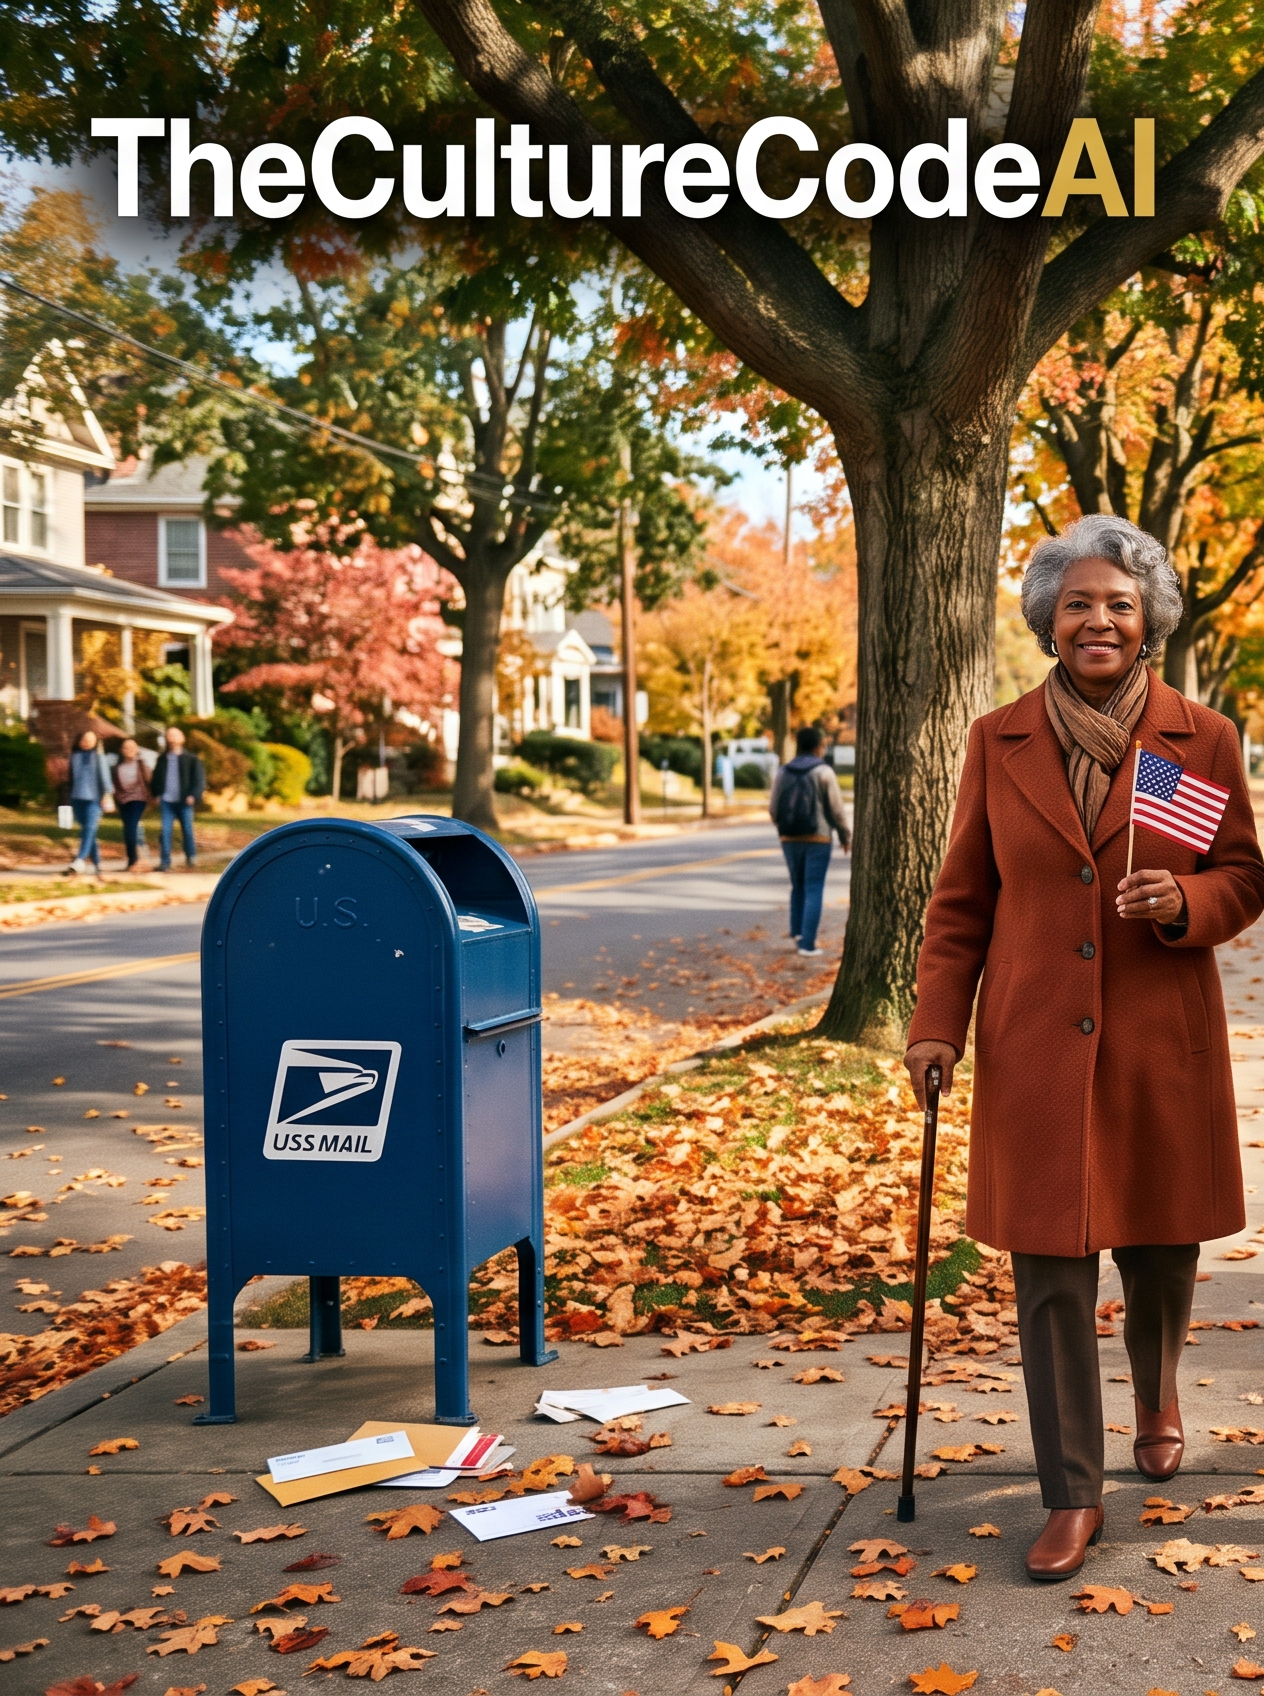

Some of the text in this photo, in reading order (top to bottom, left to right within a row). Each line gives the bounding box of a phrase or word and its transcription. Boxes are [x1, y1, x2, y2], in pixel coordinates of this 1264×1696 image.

[294, 897, 368, 928] U.S.
[273, 1133, 373, 1153] USS MAIL
